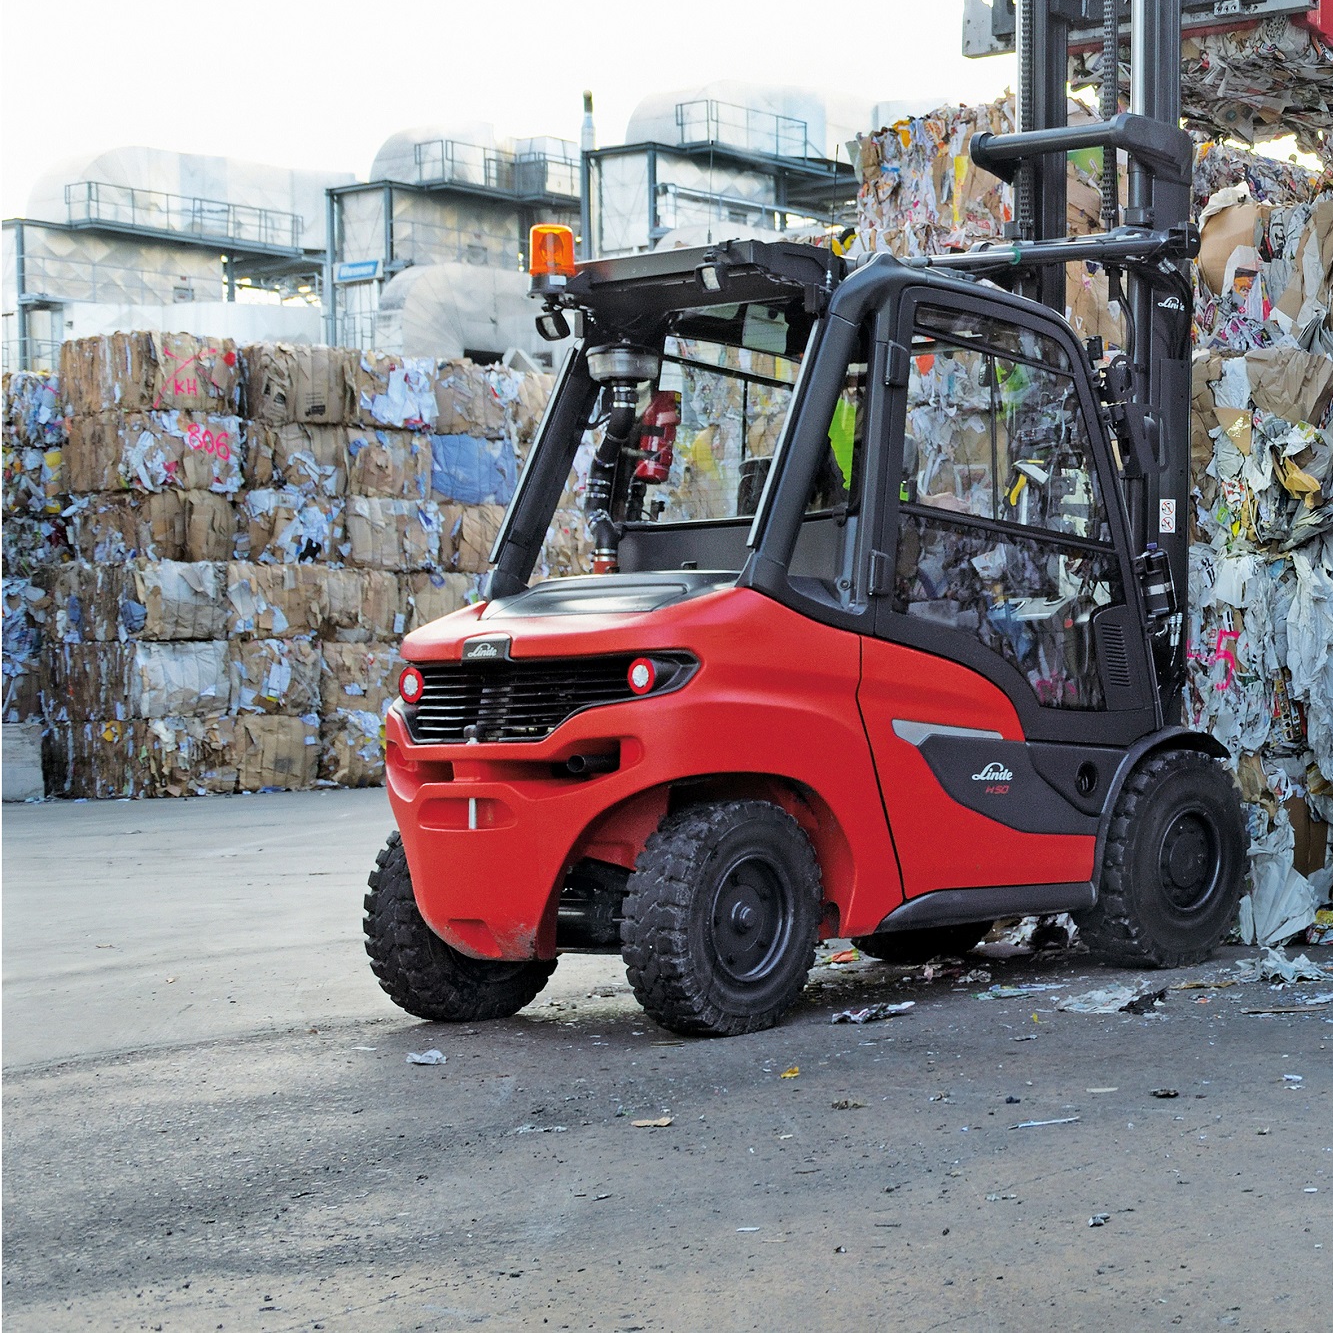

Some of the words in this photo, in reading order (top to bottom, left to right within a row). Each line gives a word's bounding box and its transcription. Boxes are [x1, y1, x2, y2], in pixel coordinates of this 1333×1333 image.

[174, 378, 197, 396] KH
[187, 423, 231, 461] 806
[467, 643, 497, 657] Linde
[971, 762, 1013, 781] Linde
